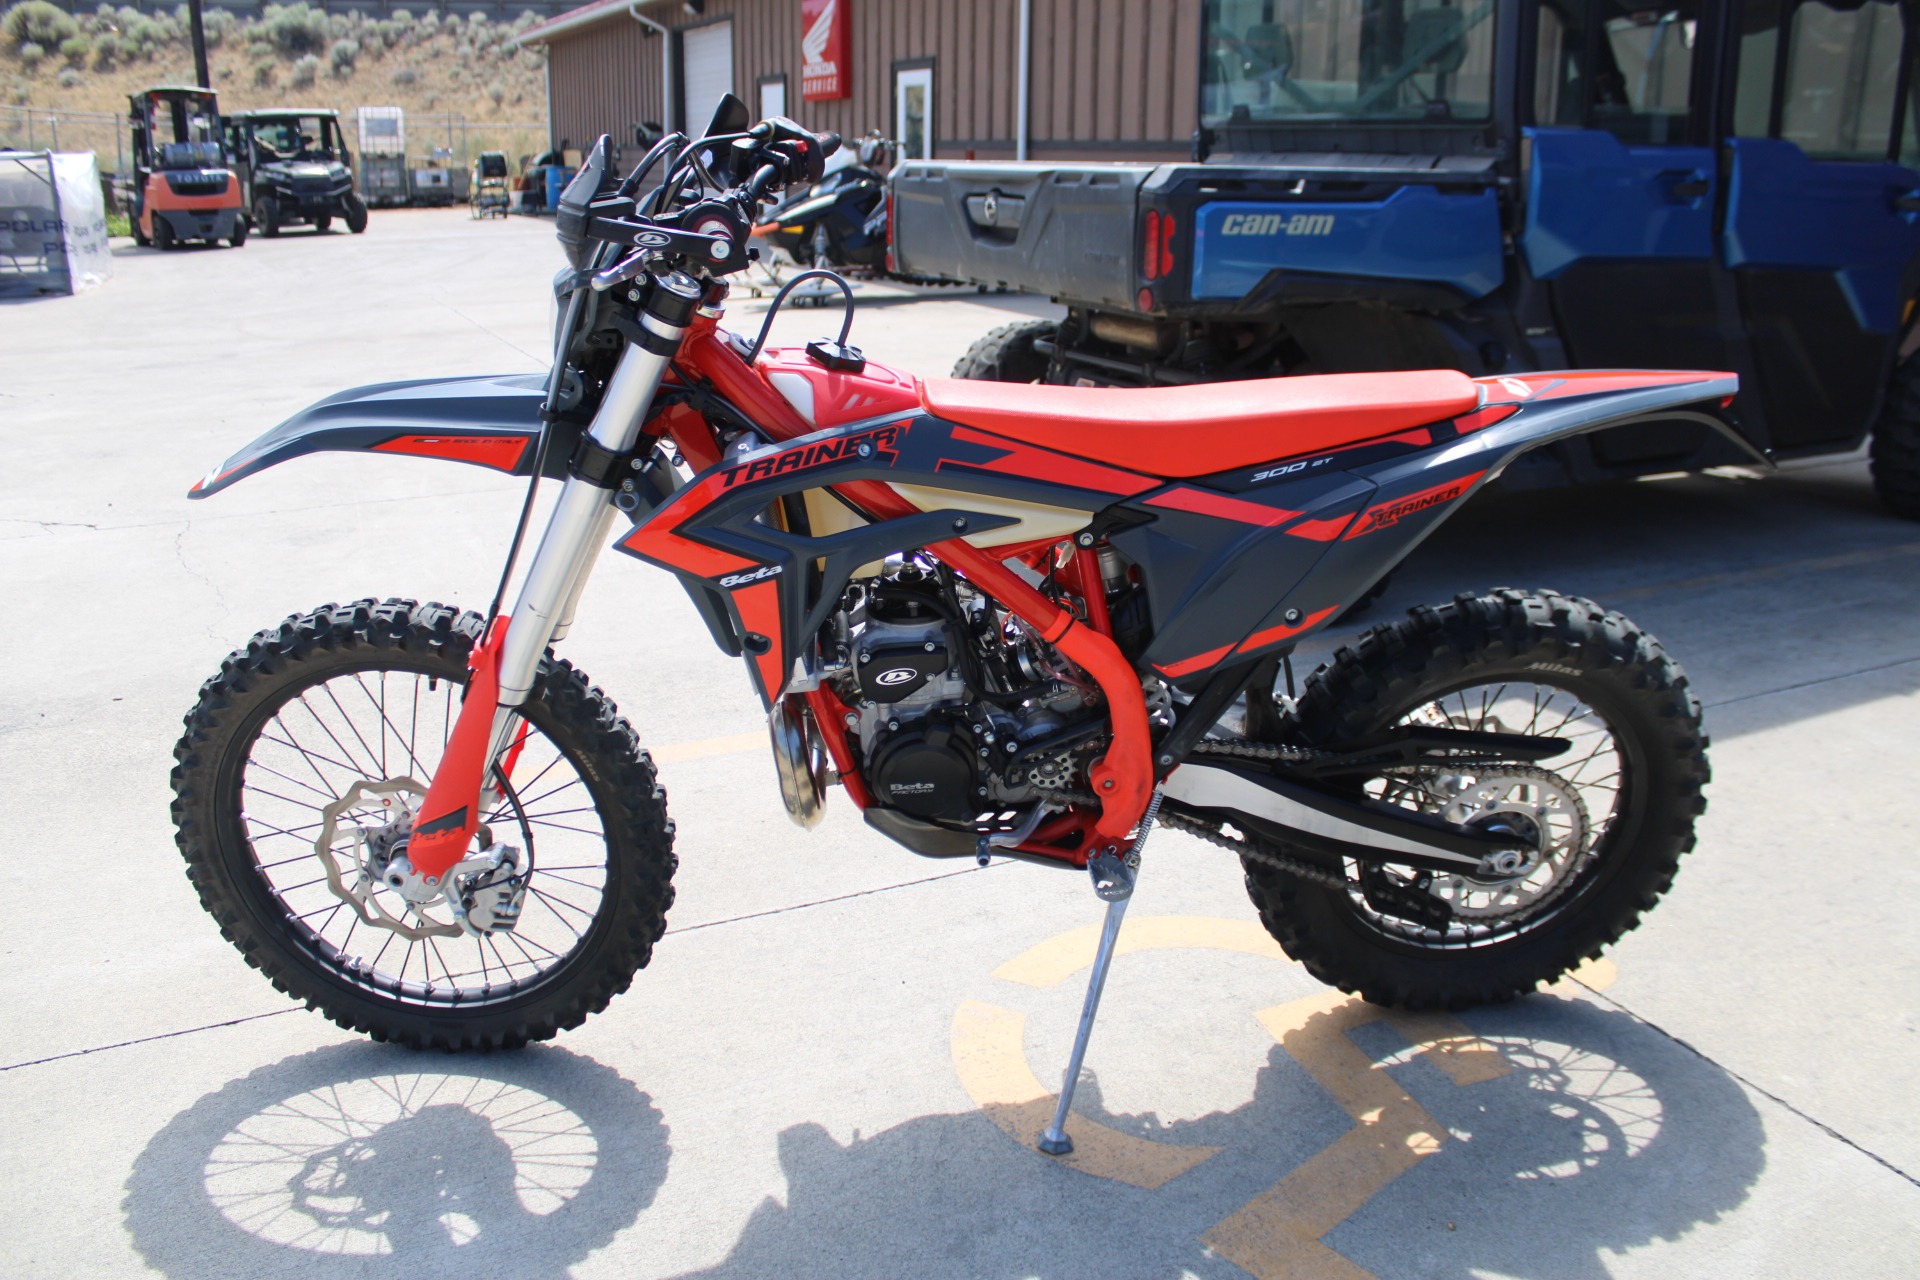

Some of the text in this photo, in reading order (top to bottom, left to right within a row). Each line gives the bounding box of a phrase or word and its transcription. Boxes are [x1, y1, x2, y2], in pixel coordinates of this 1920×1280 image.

[803, 61, 837, 78] HONDA
[803, 77, 837, 95] SERVICE
[176, 173, 223, 184] TOYOTA
[1221, 214, 1335, 235] can-am
[1251, 461, 1307, 482] 300
[719, 565, 783, 587] Beta
